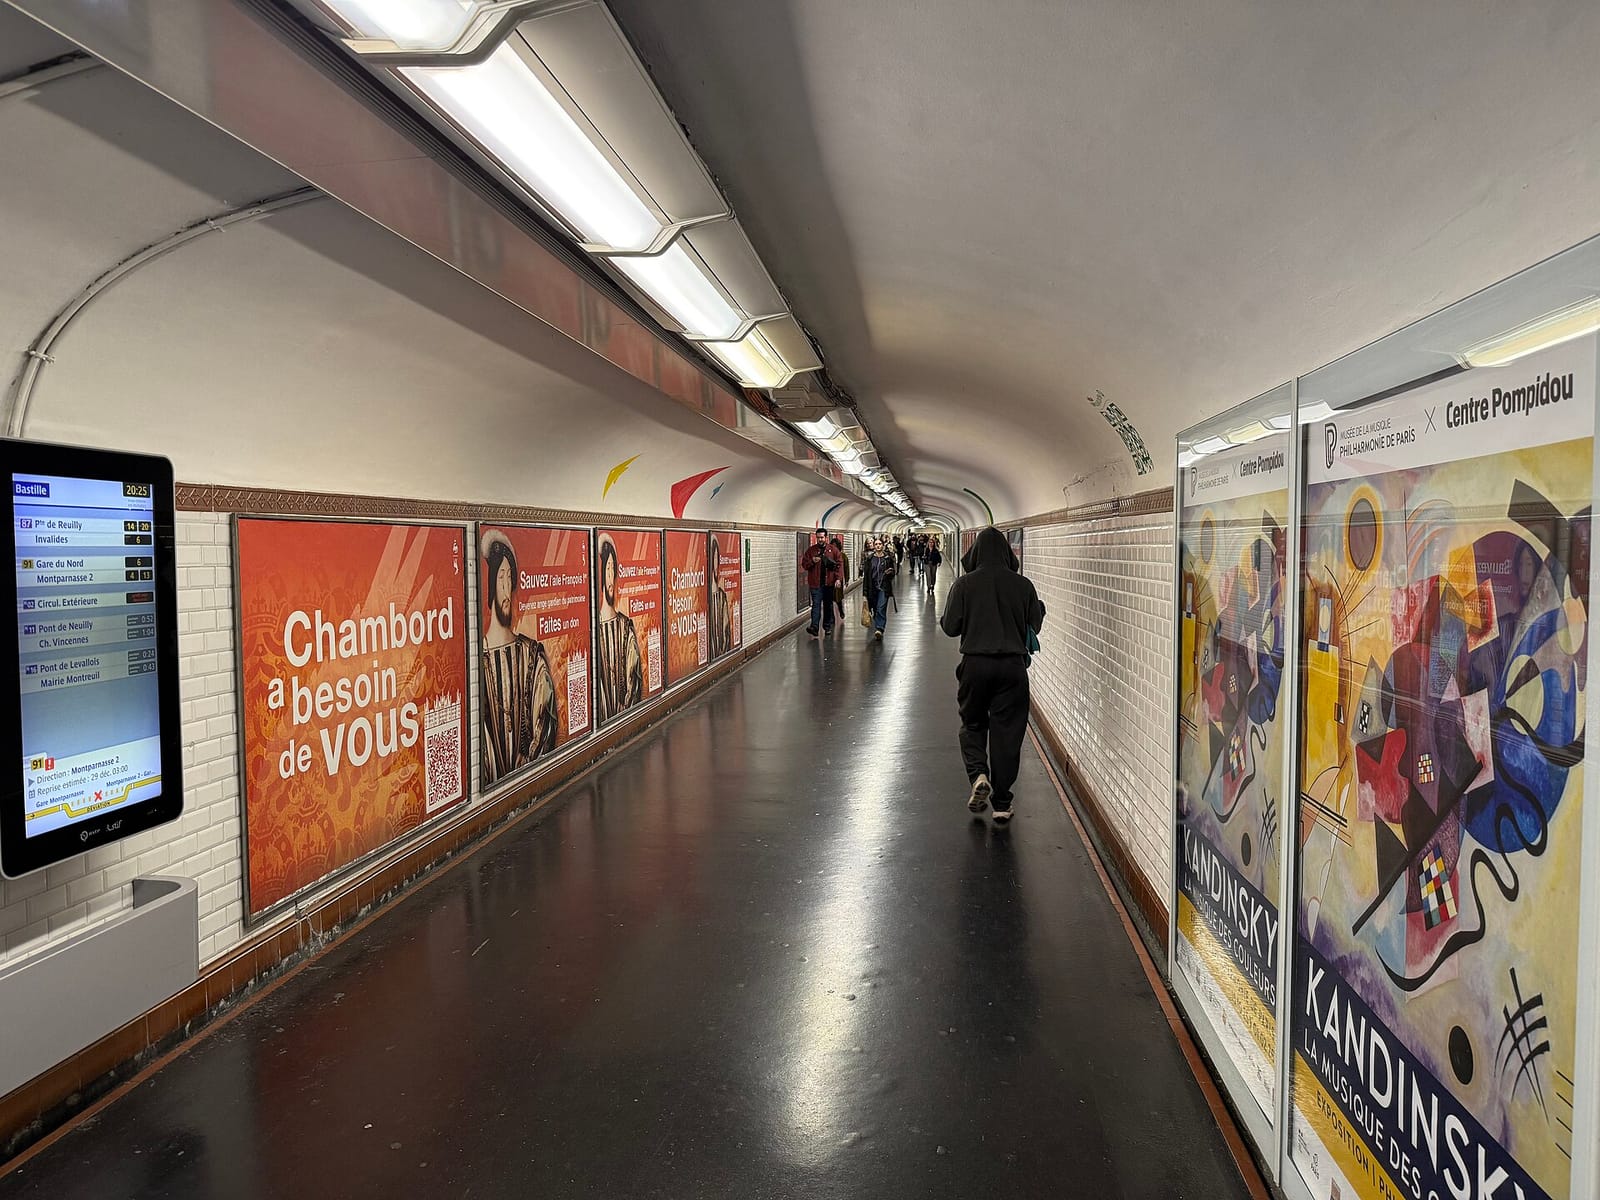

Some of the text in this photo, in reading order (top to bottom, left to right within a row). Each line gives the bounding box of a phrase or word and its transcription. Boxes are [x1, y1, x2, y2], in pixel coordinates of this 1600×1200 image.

[1446, 373, 1574, 429] Centre Pompidou
[1356, 425, 1363, 437] DE
[1363, 423, 1370, 435] LA
[1370, 418, 1392, 433] MUSIQUE
[1386, 433, 1395, 448] DE
[1240, 459, 1257, 477] Centre
[1257, 450, 1284, 474] Pompidou
[15, 483, 48, 496] Bastille
[126, 485, 148, 496] 20:25
[21, 519, 32, 528] 87
[46, 520, 57, 529] de
[58, 520, 82, 531] Reuilly
[127, 522, 135, 530] 14
[35, 535, 69, 544] Invalides
[23, 560, 33, 569] 91
[36, 560, 53, 569] Gare
[55, 559, 65, 568] du
[66, 559, 84, 568] Nord
[36, 574, 88, 584] Montparnasse
[89, 573, 94, 582] 2
[520, 570, 549, 590] Sauvez
[562, 573, 583, 587] François
[671, 566, 705, 590] Chambord
[37, 599, 60, 609] Circul.
[62, 598, 98, 607] Extérieure
[672, 592, 693, 614] besoin
[38, 624, 56, 633] Pont
[57, 623, 67, 632] de
[68, 621, 94, 631] Neuilly
[284, 597, 454, 667] Chambord
[539, 615, 580, 635] Faites un don
[38, 639, 51, 649] Ch.
[53, 636, 89, 647] Vincennes
[40, 664, 58, 673] Pont
[58, 662, 68, 671] de
[70, 658, 100, 669] Levallois
[40, 677, 65, 688] Mairie
[66, 672, 100, 684] Montreuil
[267, 659, 397, 726] a besoin
[32, 758, 43, 770] 91
[279, 739, 312, 779] de
[37, 771, 67, 785] Direction
[71, 760, 115, 775] Montparnasse
[115, 755, 120, 764] 2
[37, 785, 61, 797] Reprise
[62, 778, 86, 789] estimée
[91, 774, 99, 782] 29
[106, 774, 137, 787] Montparnasse
[36, 790, 85, 808] Gare Montparnasse
[1183, 823, 1279, 968] KANDINSKY
[1218, 918, 1233, 949] DES
[1233, 938, 1276, 1007] COULEURS
[1304, 957, 1526, 1200] KANDINSK
[1304, 1028, 1421, 1200] LA MUSIQUE DES
[1316, 1090, 1370, 1174] EXPOSITION
